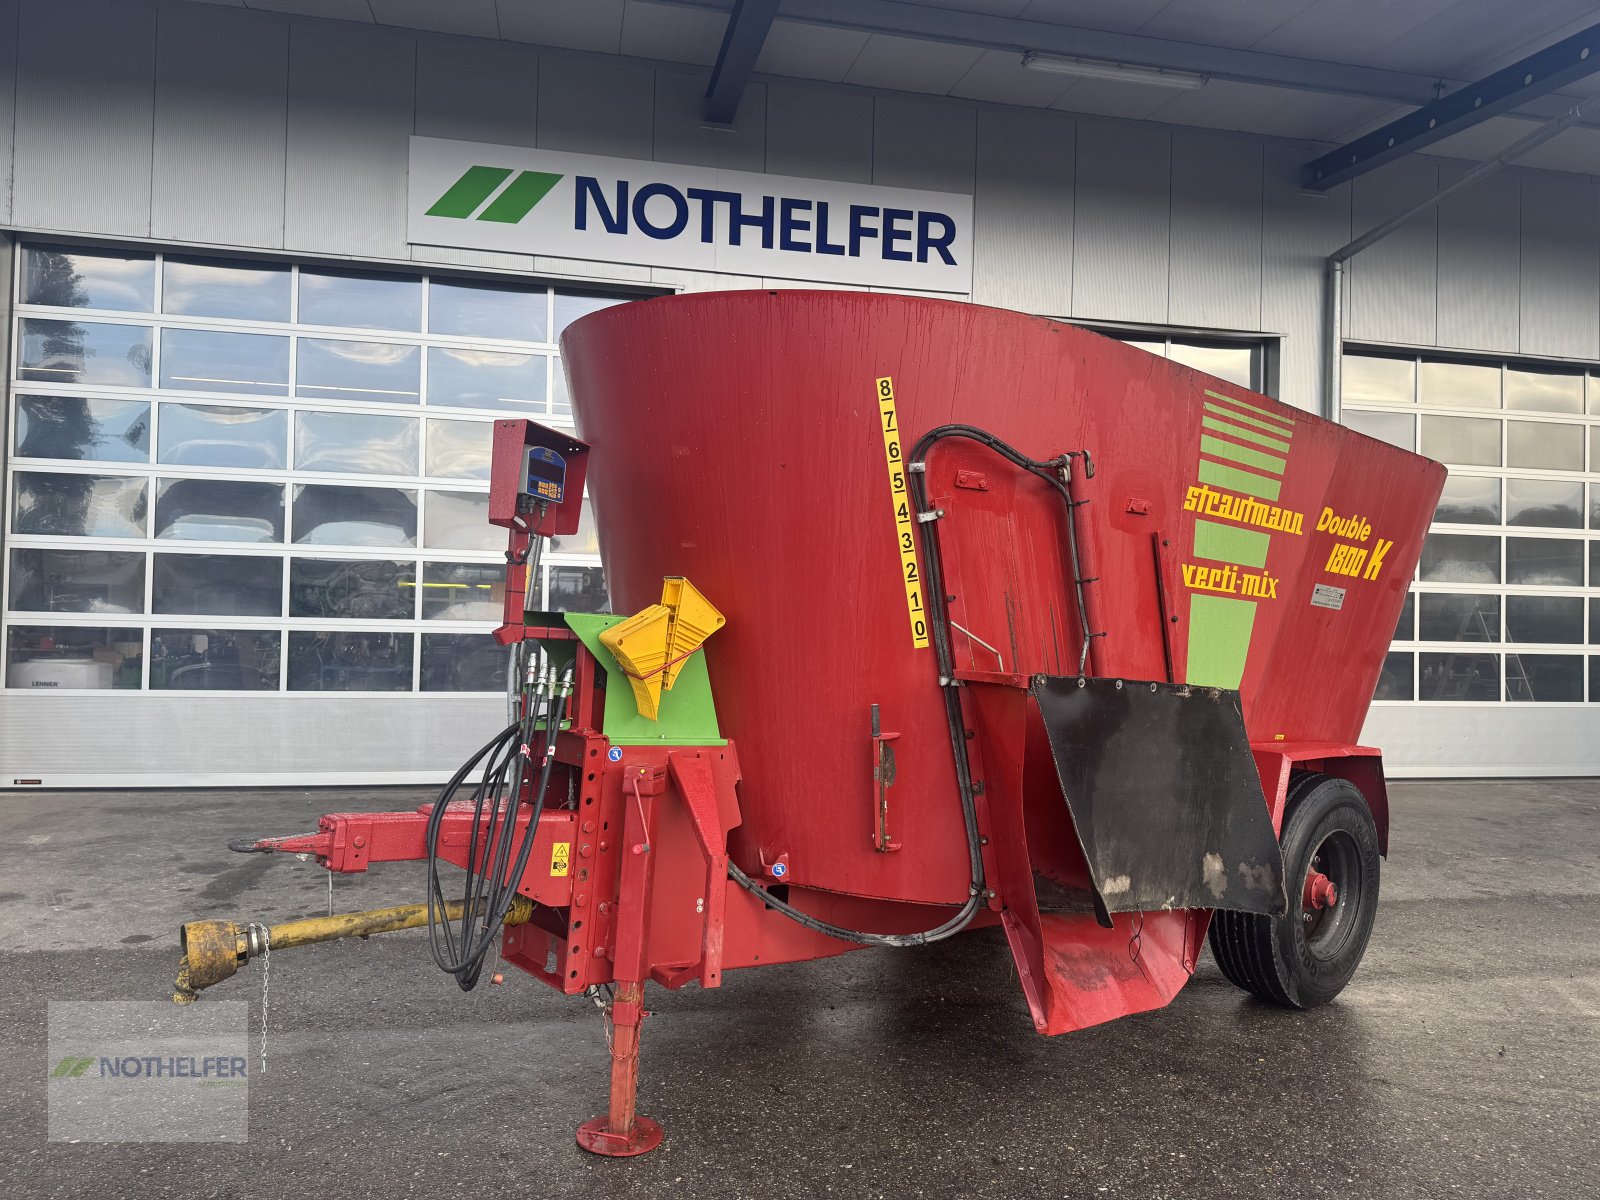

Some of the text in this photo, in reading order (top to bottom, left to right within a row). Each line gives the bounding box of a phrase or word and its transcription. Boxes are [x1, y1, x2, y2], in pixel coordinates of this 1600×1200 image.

[575, 175, 957, 266] NOTHELFER
[880, 380, 891, 396] 8
[884, 411, 894, 427] 7
[888, 442, 900, 458] 6
[893, 472, 904, 489] 5
[897, 502, 909, 518] 4
[1183, 484, 1304, 536] strautmann
[1316, 506, 1372, 542] Double
[901, 533, 913, 548] 3
[1324, 538, 1394, 581] 1800 K
[906, 562, 917, 578] 2
[1181, 563, 1279, 599] verti-mix
[910, 592, 919, 607] 1
[915, 621, 925, 636] 0
